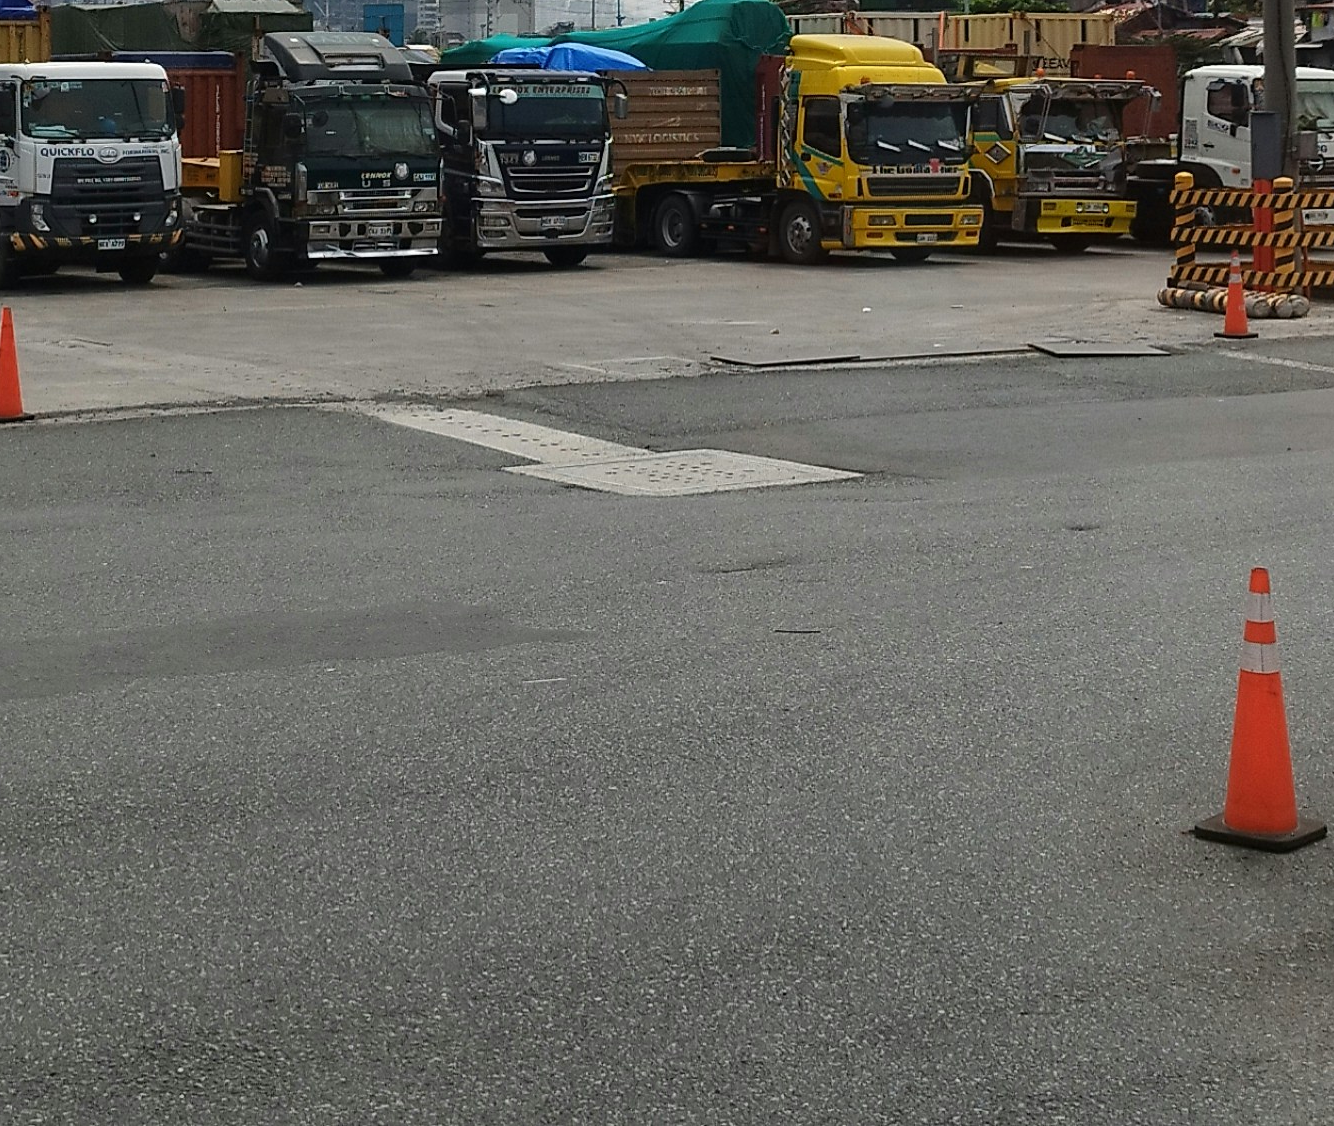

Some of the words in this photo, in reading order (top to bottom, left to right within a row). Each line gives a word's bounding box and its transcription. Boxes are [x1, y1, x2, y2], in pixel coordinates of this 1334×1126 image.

[532, 85, 591, 94] ENTERPRISES
[648, 133, 700, 143] LOGISTICS
[40, 147, 95, 157] QUICKFLO
[361, 172, 393, 180] LENNOX
